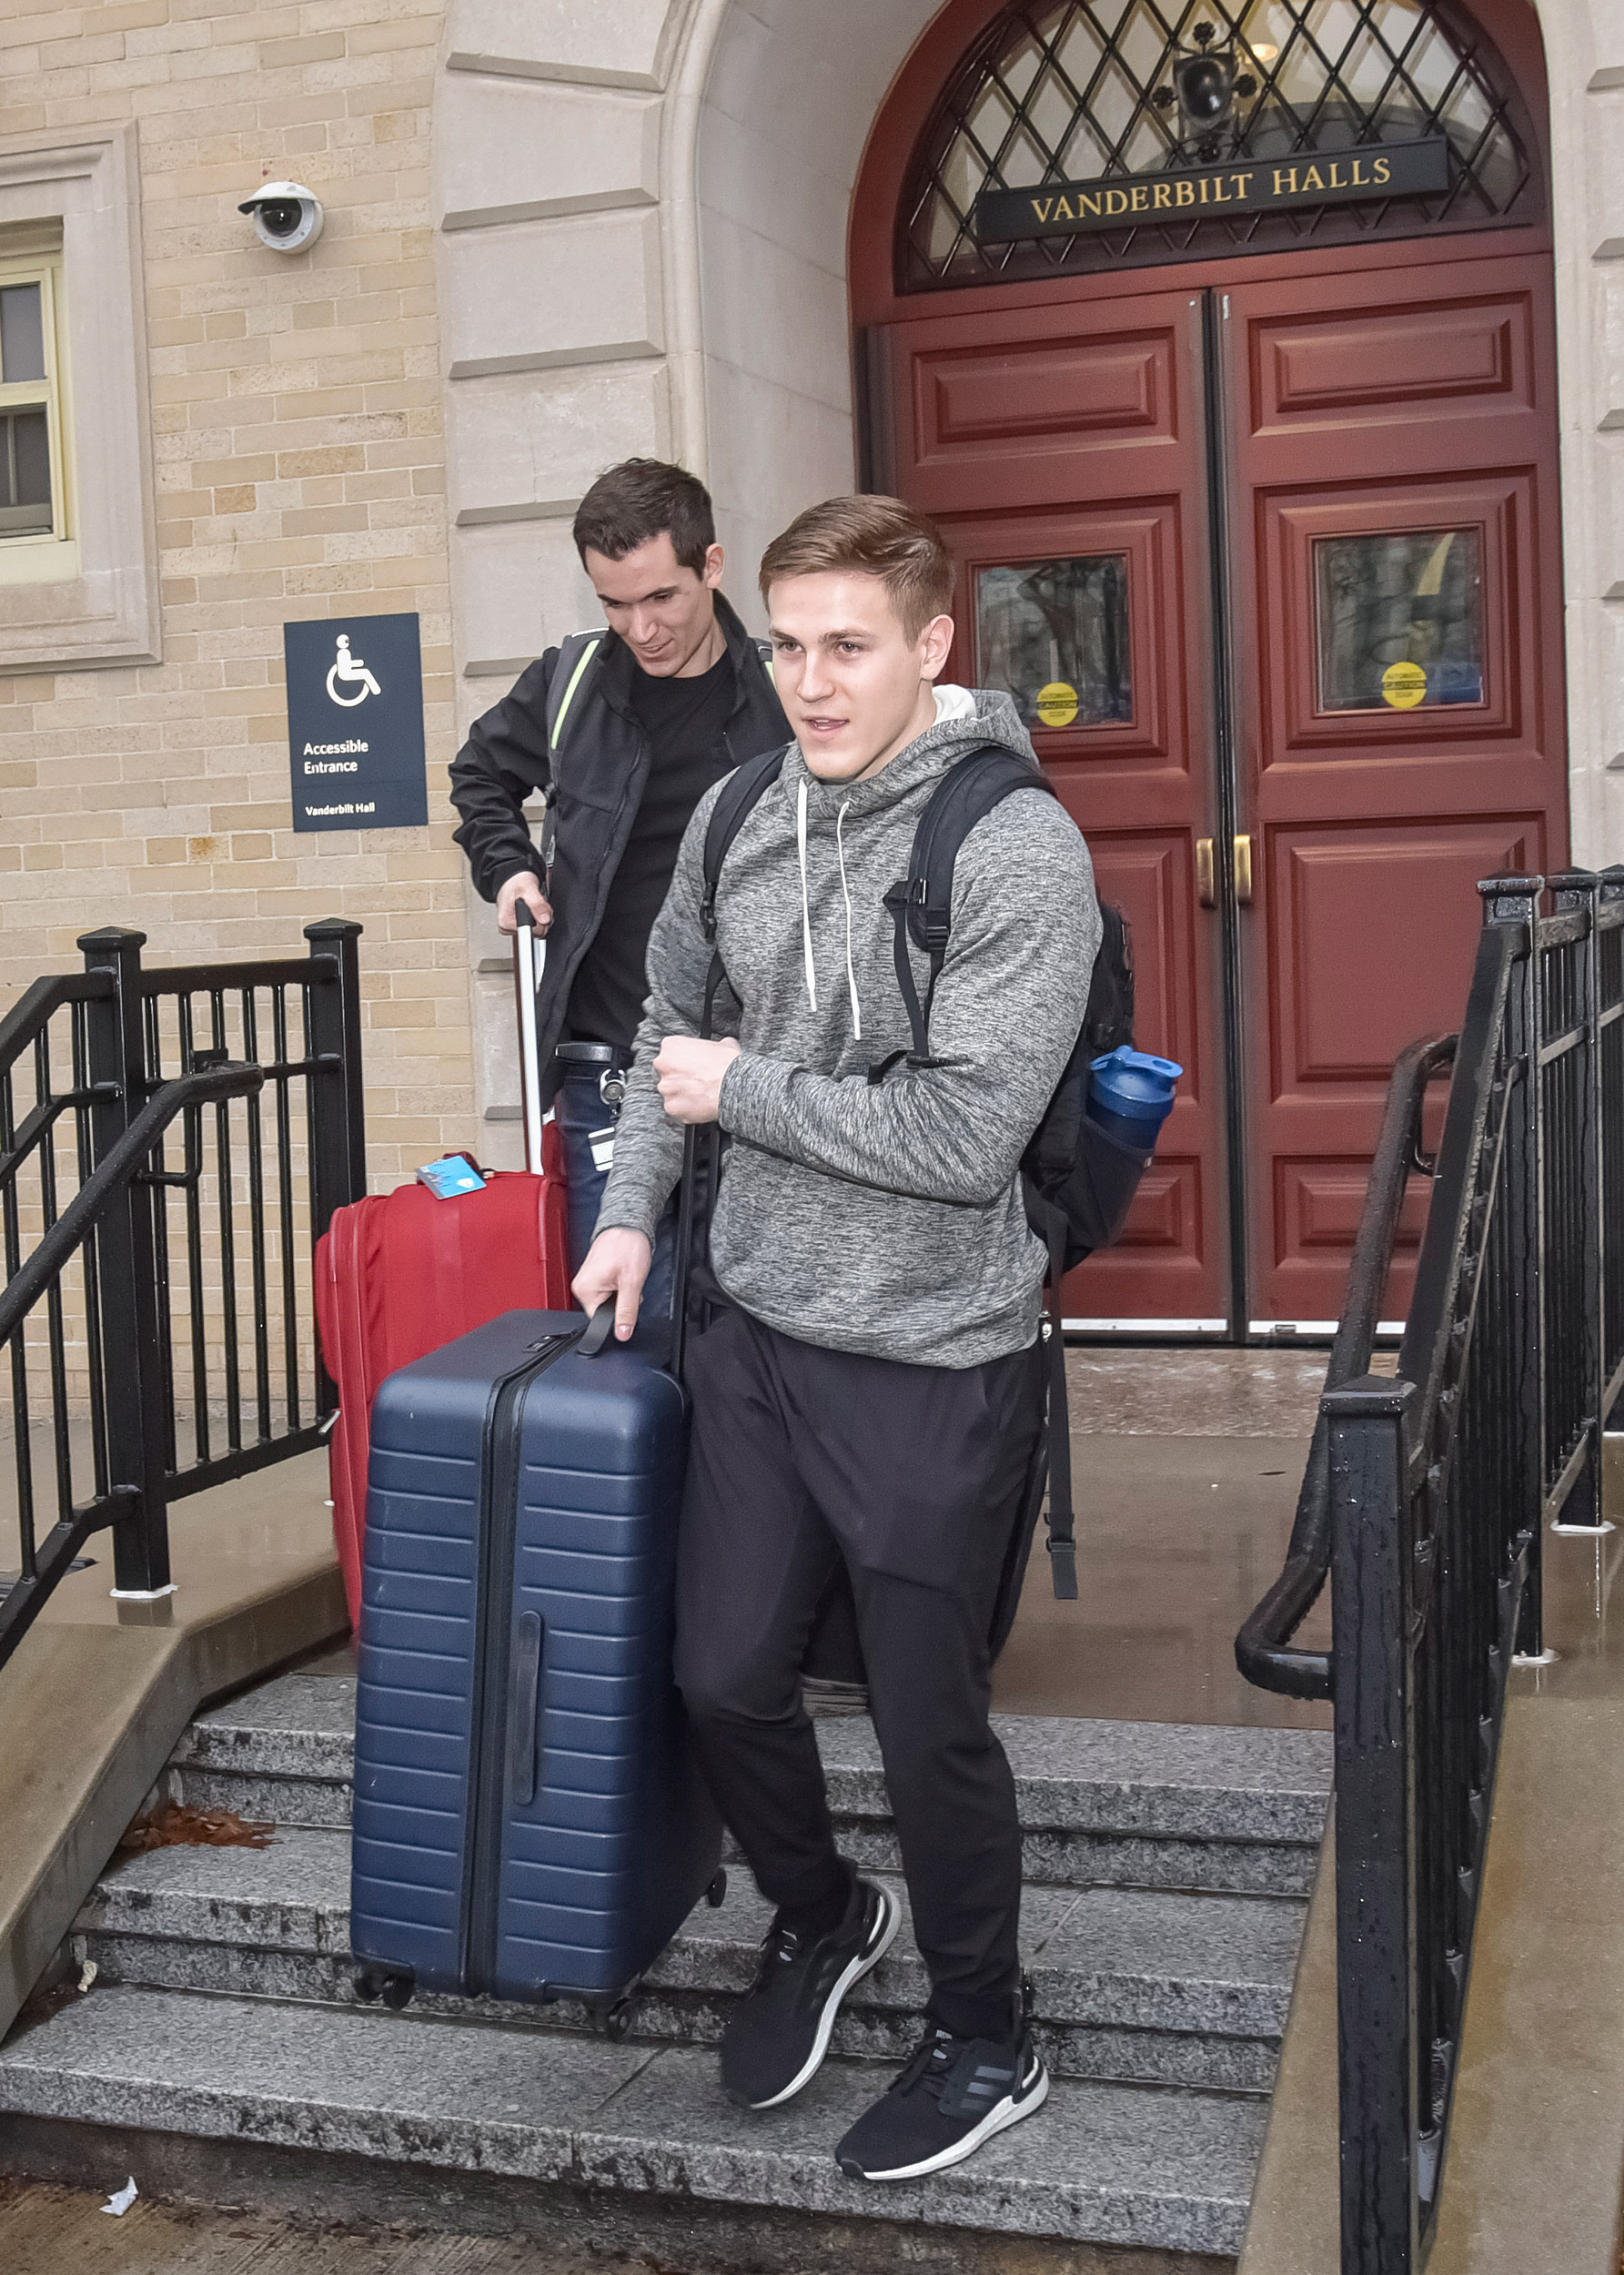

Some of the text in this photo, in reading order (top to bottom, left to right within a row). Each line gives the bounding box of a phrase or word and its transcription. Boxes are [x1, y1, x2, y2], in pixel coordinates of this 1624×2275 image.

[1030, 157, 1391, 223] VANDERBILT HALLS
[303, 739, 368, 756] Accessible
[303, 761, 358, 774] Entrance
[305, 802, 376, 816] Vanderbilt Hall
